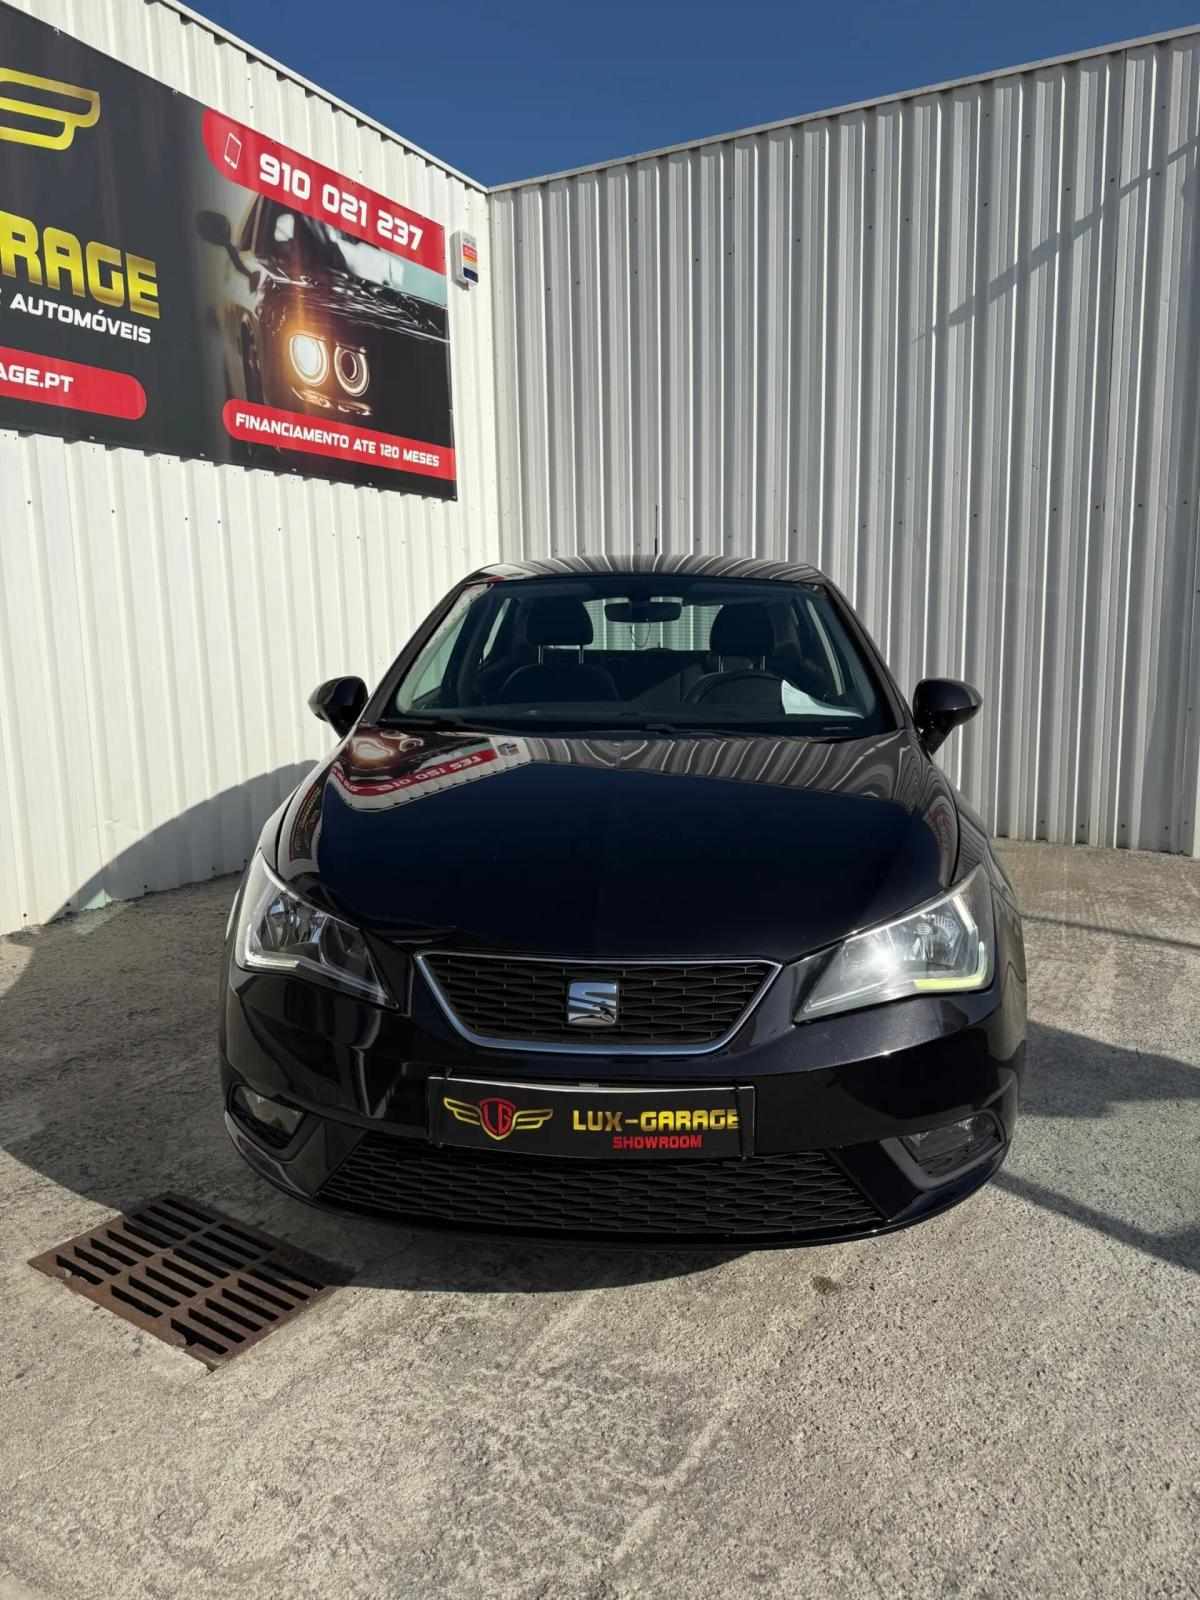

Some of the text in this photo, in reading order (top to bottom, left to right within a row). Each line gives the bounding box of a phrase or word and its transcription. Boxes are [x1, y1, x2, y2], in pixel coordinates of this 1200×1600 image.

[259, 152, 424, 251] 910 021 237
[0, 210, 160, 319] RAGE
[9, 292, 151, 344] AUTOMÓVEIS
[235, 412, 440, 467] FINANCIAMENTO ATE 120 MESES
[572, 1108, 739, 1132] LUX-GARAGE
[612, 1135, 703, 1150] SHOWROOM
